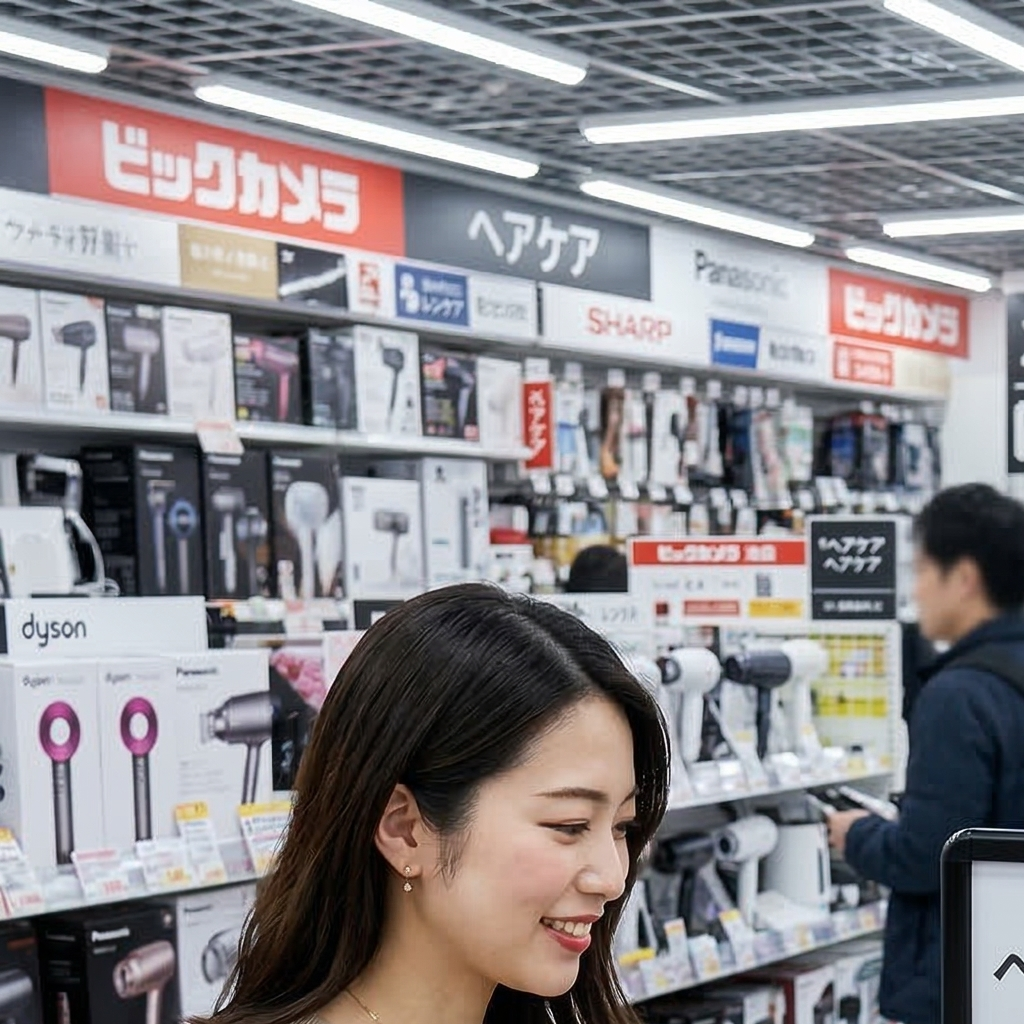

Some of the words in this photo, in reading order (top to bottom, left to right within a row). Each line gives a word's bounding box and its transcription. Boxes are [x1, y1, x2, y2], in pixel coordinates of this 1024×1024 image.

[102, 119, 361, 235] ビックカメラ
[468, 208, 599, 277] ヘアケア
[694, 250, 789, 299] Panasonic
[586, 307, 672, 343] SHARP
[843, 284, 961, 348] ビックカメラ
[22, 613, 87, 648] dyson
